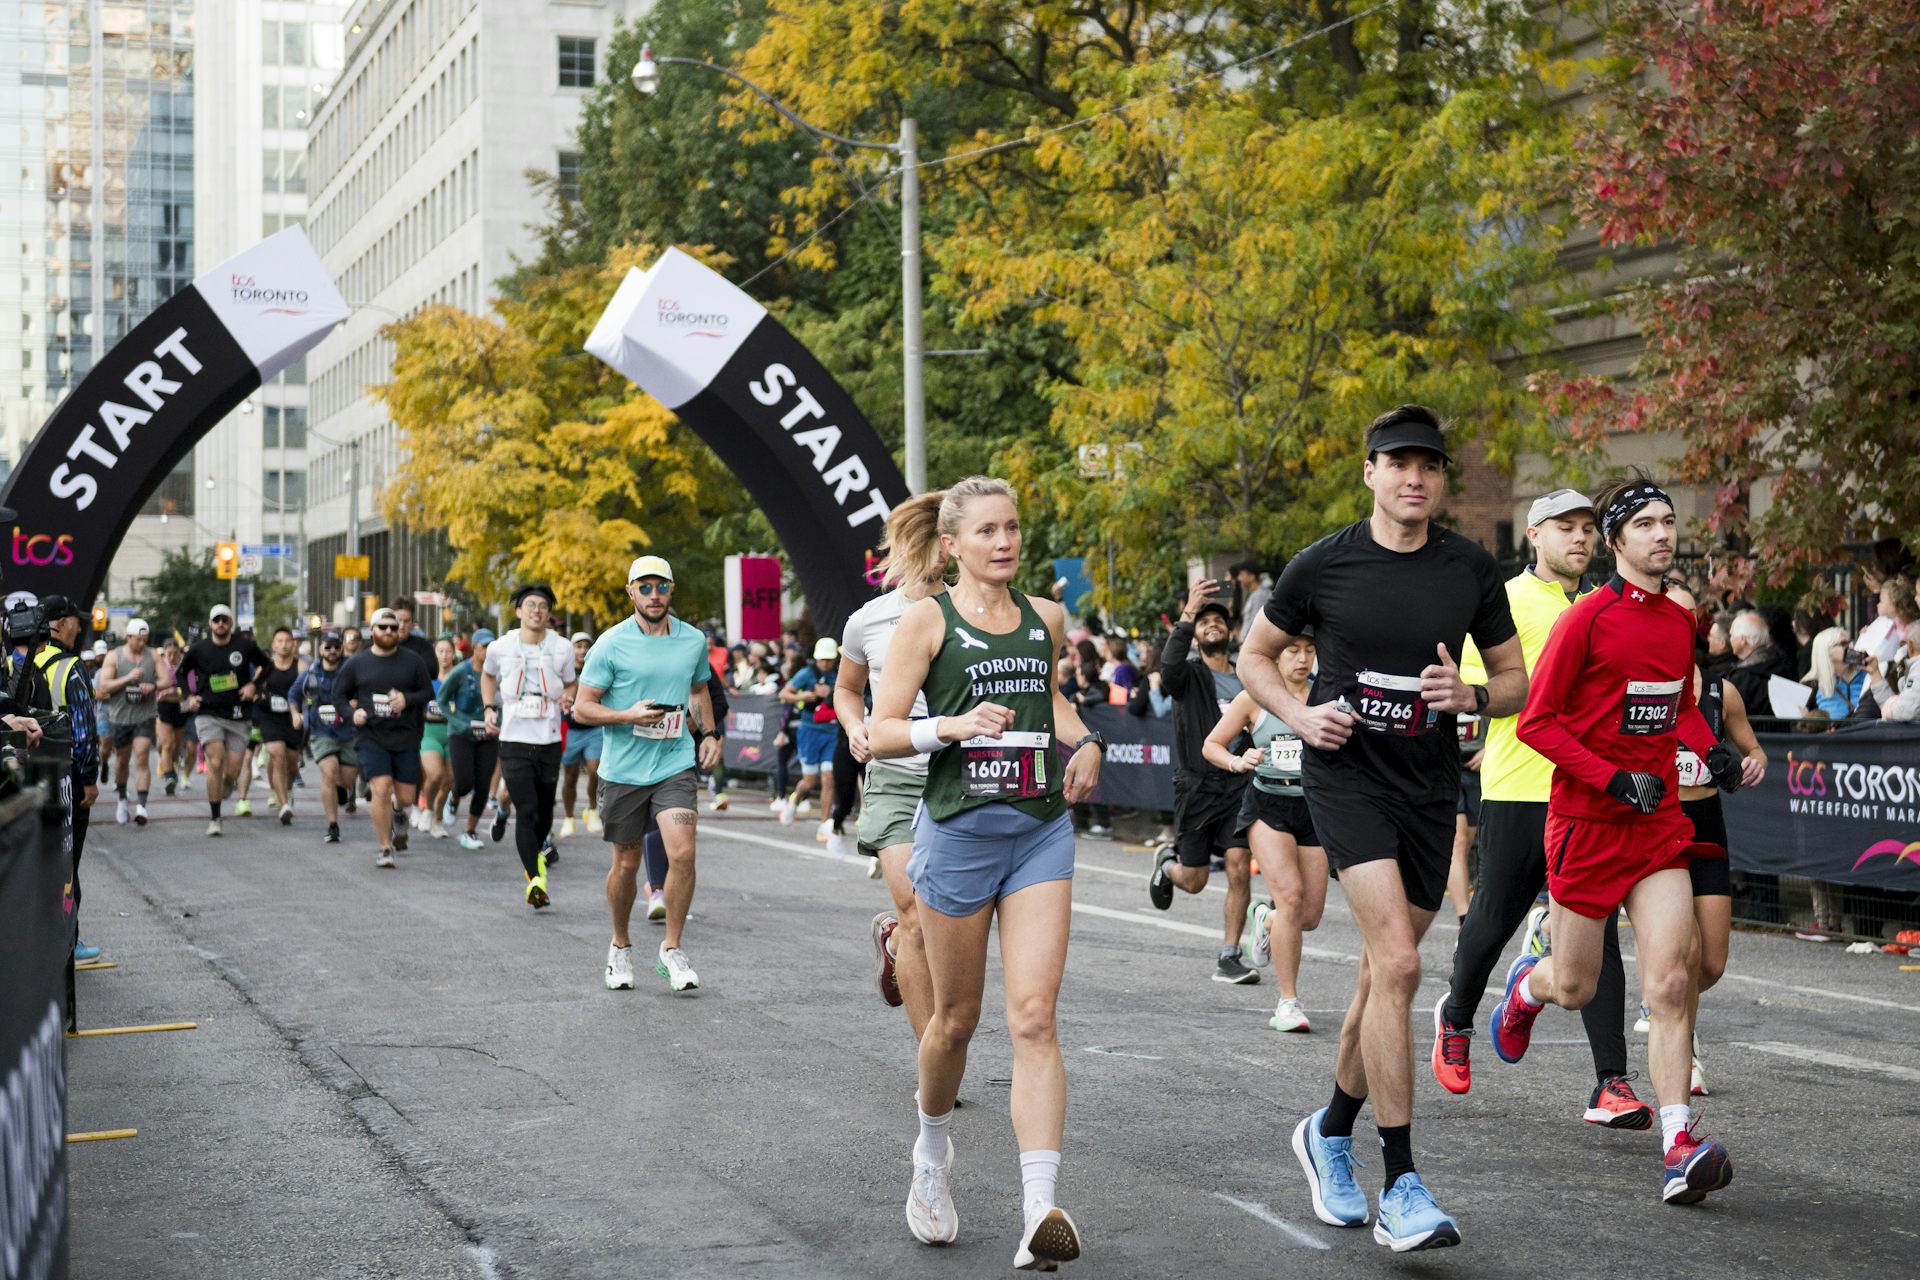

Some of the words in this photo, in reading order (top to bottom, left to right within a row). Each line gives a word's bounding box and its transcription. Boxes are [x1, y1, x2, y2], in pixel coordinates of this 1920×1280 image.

[232, 288, 308, 302] TORONTO
[658, 312, 729, 325] TORONTO
[49, 326, 203, 511] START
[749, 363, 892, 528] START
[12, 526, 74, 565] tcs
[965, 657, 1048, 680] TORONTO
[972, 678, 1046, 696] HARRIERS
[1363, 687, 1384, 698] PAUL
[1360, 698, 1413, 720] 12766
[1629, 705, 1668, 720] 17302
[968, 751, 1003, 759] KIRSTEN
[968, 760, 1020, 778] 16071
[1787, 750, 1826, 797] tcs
[1790, 798, 1879, 820] WATERFRONT
